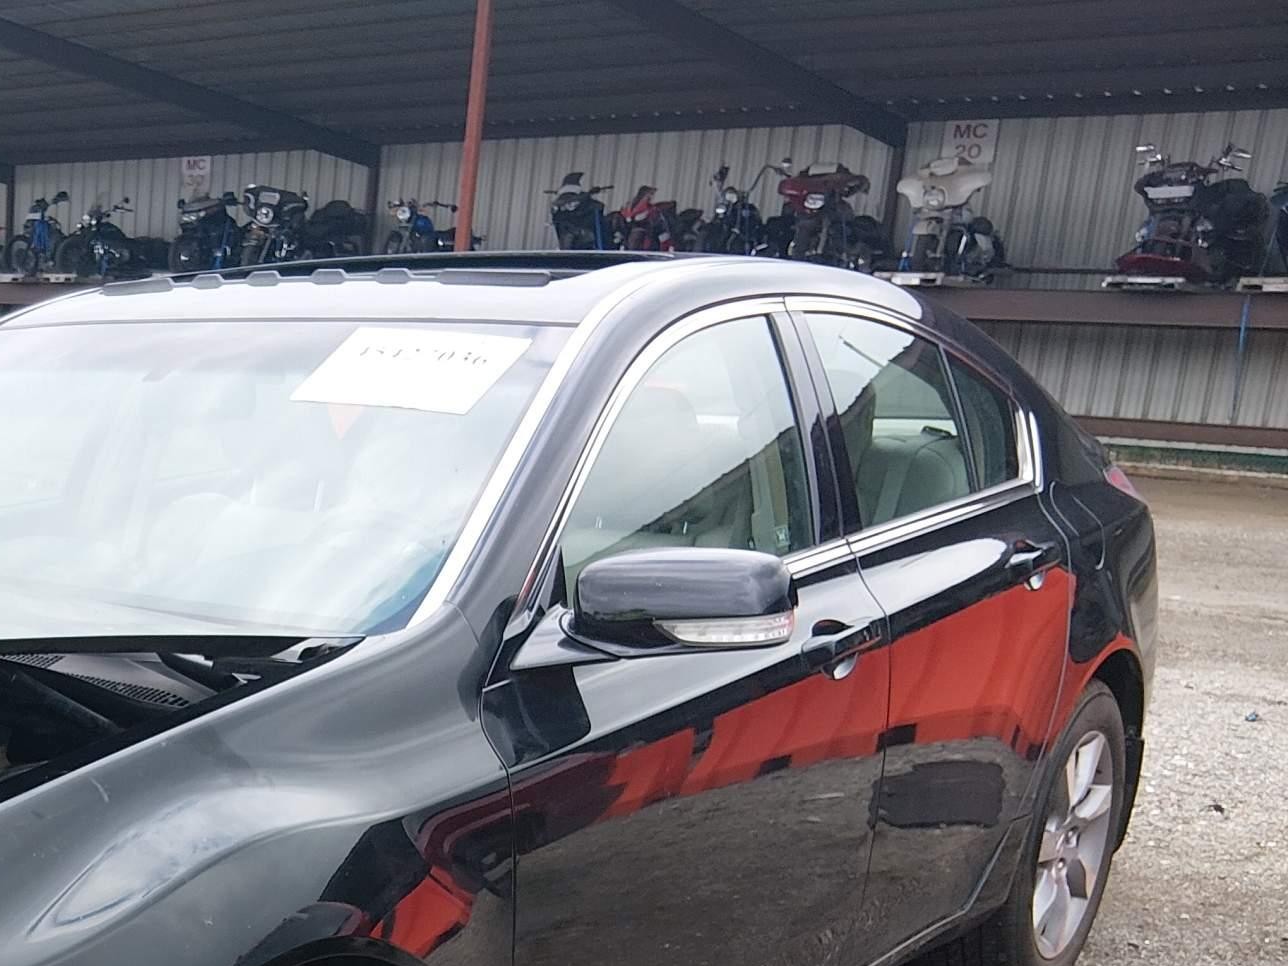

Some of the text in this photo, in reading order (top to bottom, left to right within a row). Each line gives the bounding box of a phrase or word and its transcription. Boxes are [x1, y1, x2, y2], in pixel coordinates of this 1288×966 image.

[953, 123, 989, 139] MC
[954, 143, 983, 159] 20
[185, 159, 207, 170] MC
